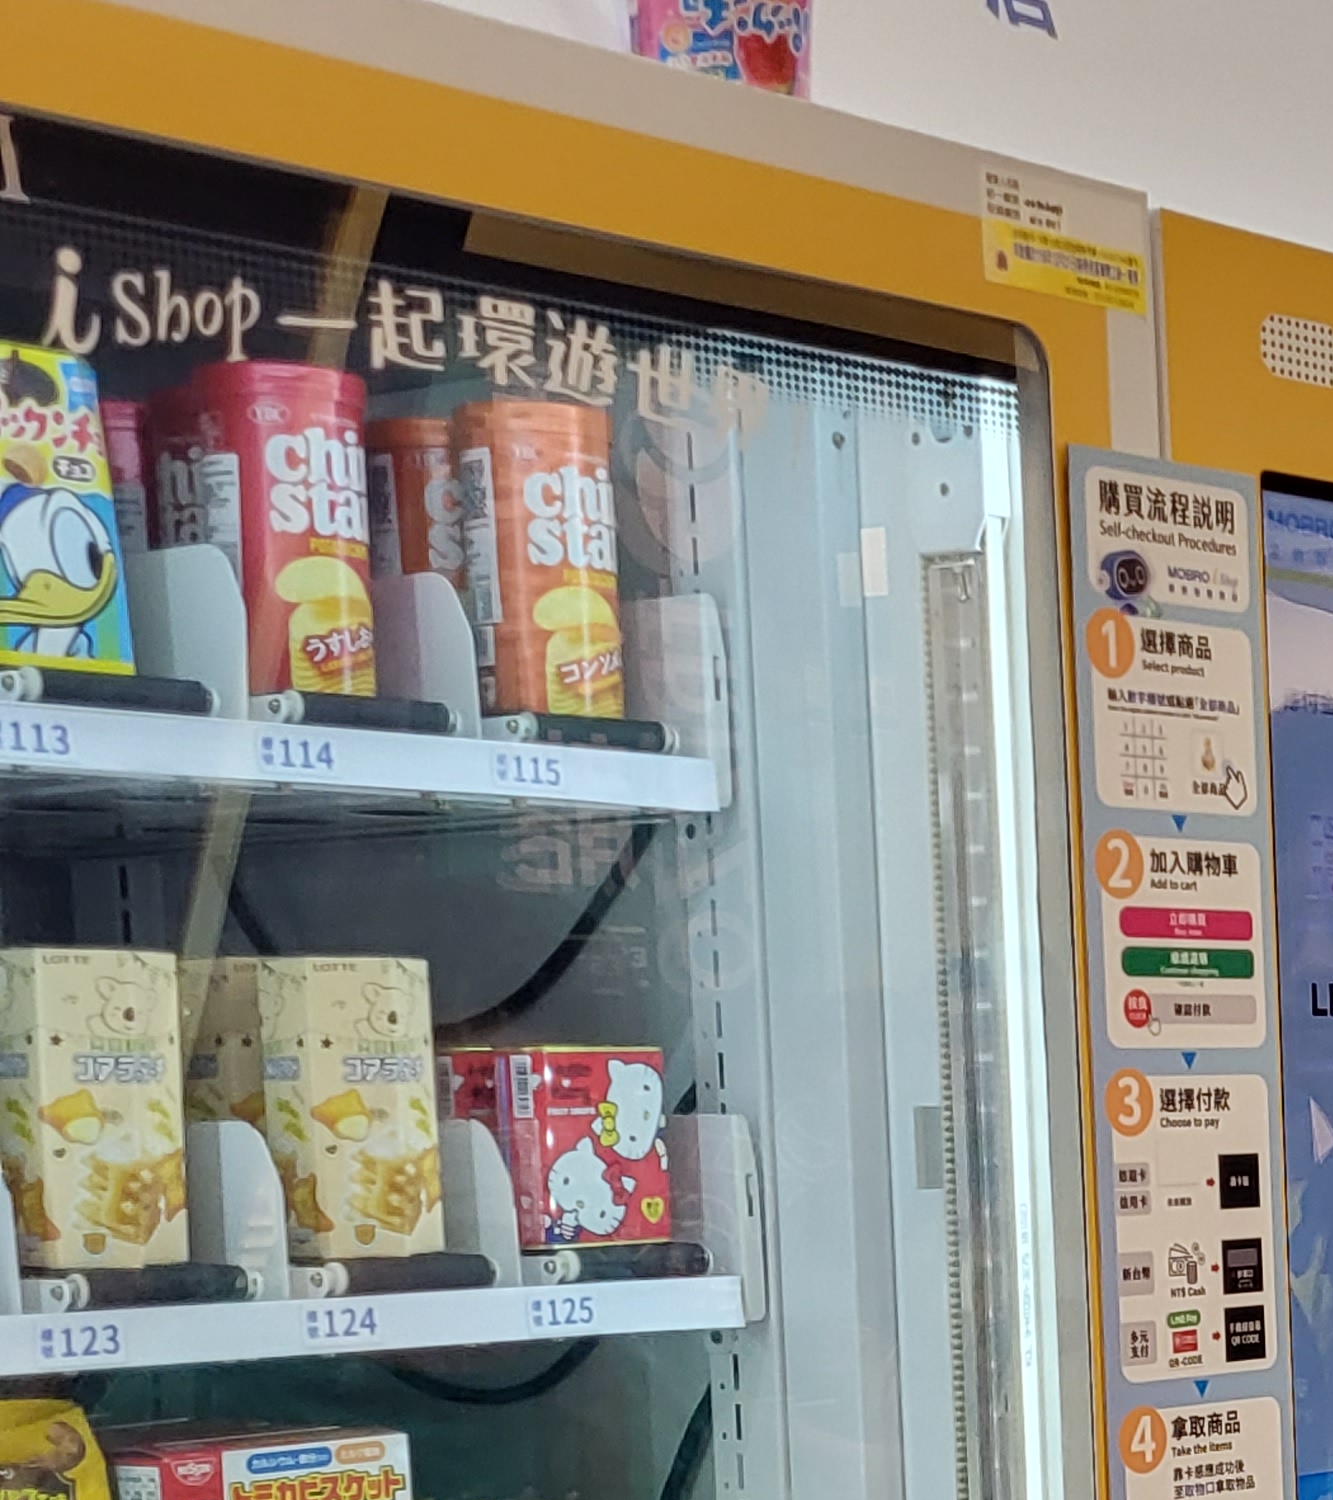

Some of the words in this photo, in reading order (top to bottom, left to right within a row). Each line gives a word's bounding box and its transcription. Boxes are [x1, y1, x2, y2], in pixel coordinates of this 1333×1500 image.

[112, 269, 262, 362] Shop
[1100, 519, 1175, 548] Self-checkout
[1178, 534, 1237, 557] Procedures
[1101, 619, 1118, 669] 1
[1141, 627, 1212, 661] 選擇商品
[279, 739, 335, 769] 114
[512, 755, 561, 787] 115
[1107, 837, 1133, 889] 2
[1150, 848, 1239, 878] 加入購物車
[1151, 879, 1168, 891] Add
[1182, 880, 1199, 892] cart
[1117, 1076, 1142, 1127] 3
[1159, 1087, 1231, 1113] 選擇付款
[323, 1307, 378, 1338] 124
[548, 1297, 595, 1327] 125
[60, 1325, 121, 1358] 123
[1131, 1415, 1156, 1463] 4
[1171, 1410, 1241, 1441] 拿取商品
[1172, 1446, 1192, 1459] Take
[1193, 1444, 1208, 1456] the
